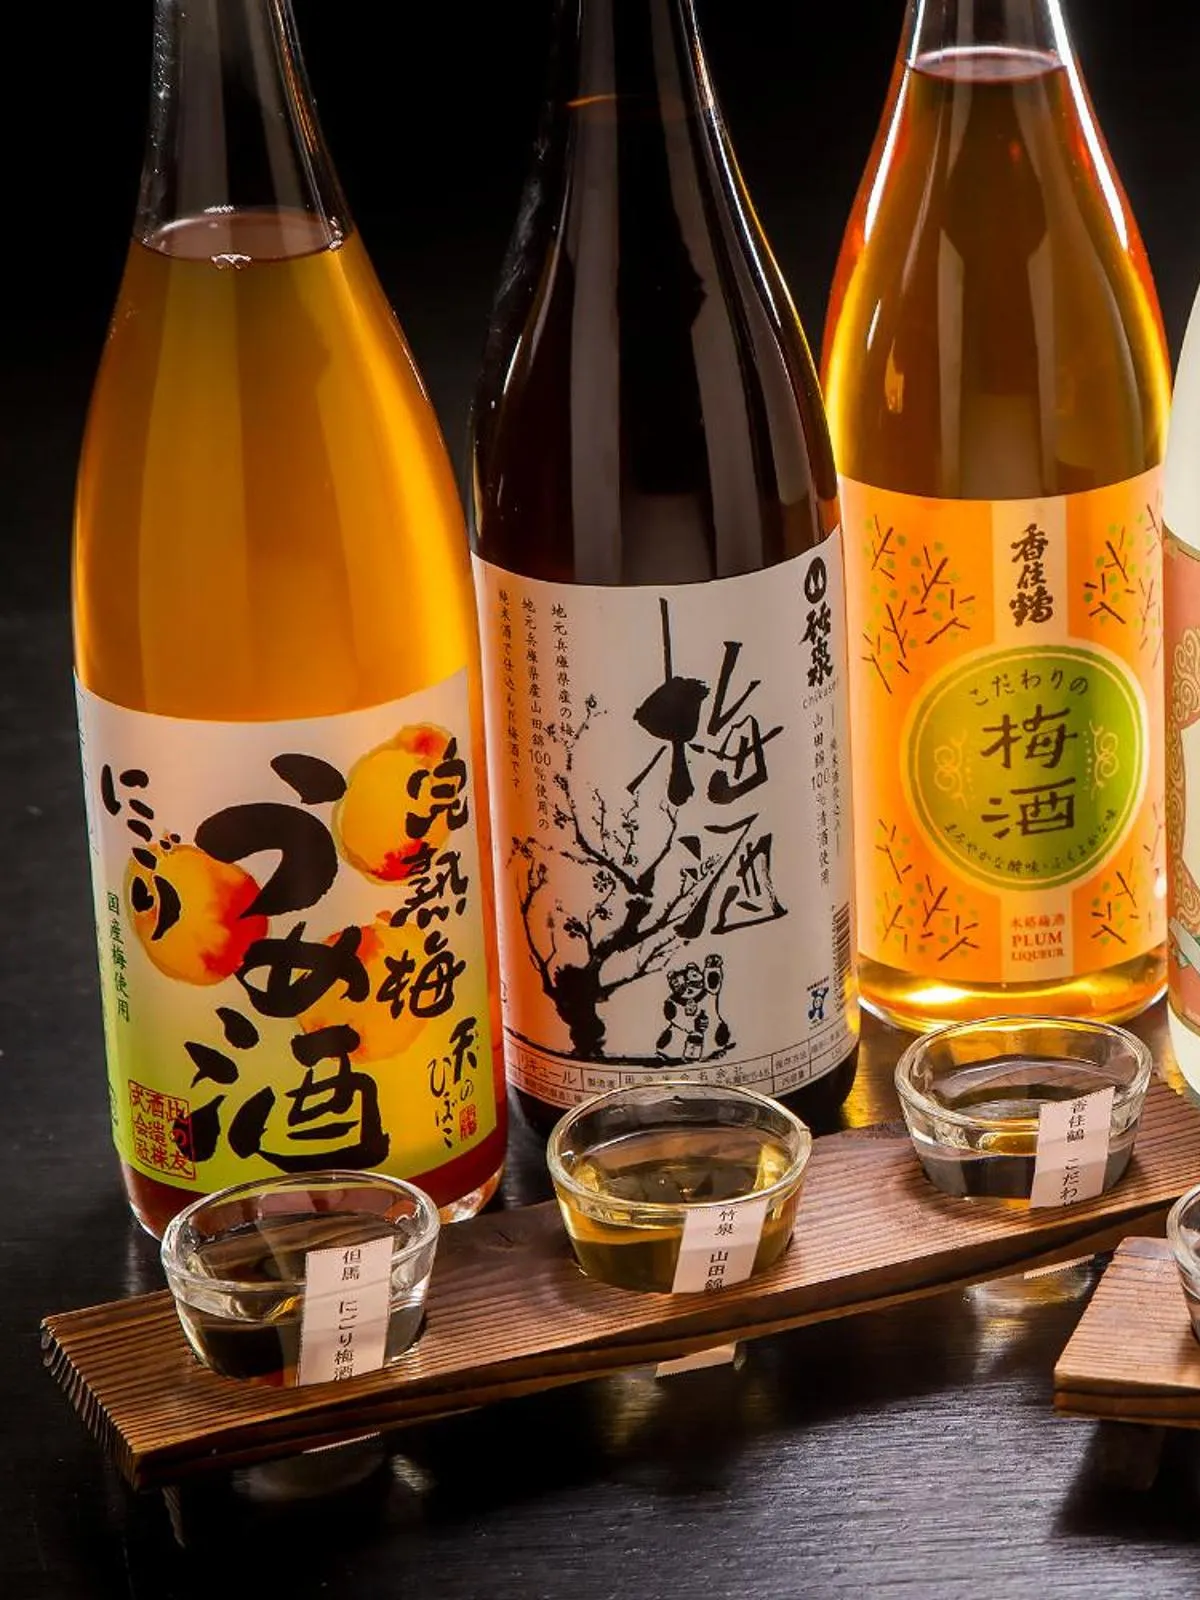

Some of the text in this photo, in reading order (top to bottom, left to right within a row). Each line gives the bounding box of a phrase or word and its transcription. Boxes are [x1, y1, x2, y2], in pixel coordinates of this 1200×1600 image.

[1009, 523, 1054, 627] 香住鶴
[969, 669, 1089, 706] こだわりの
[626, 597, 790, 938] 梅酒
[980, 704, 1079, 840] 梅酒
[101, 764, 180, 940] にごり
[376, 737, 470, 1019] 完熟梅
[178, 753, 390, 1171] うめ酒
[1012, 931, 1062, 947] PLUM
[1012, 948, 1064, 962] LIQUEUR
[1060, 1158, 1081, 1206] こだわ
[714, 1209, 738, 1236] 竹泉
[342, 1248, 362, 1281] 但馬
